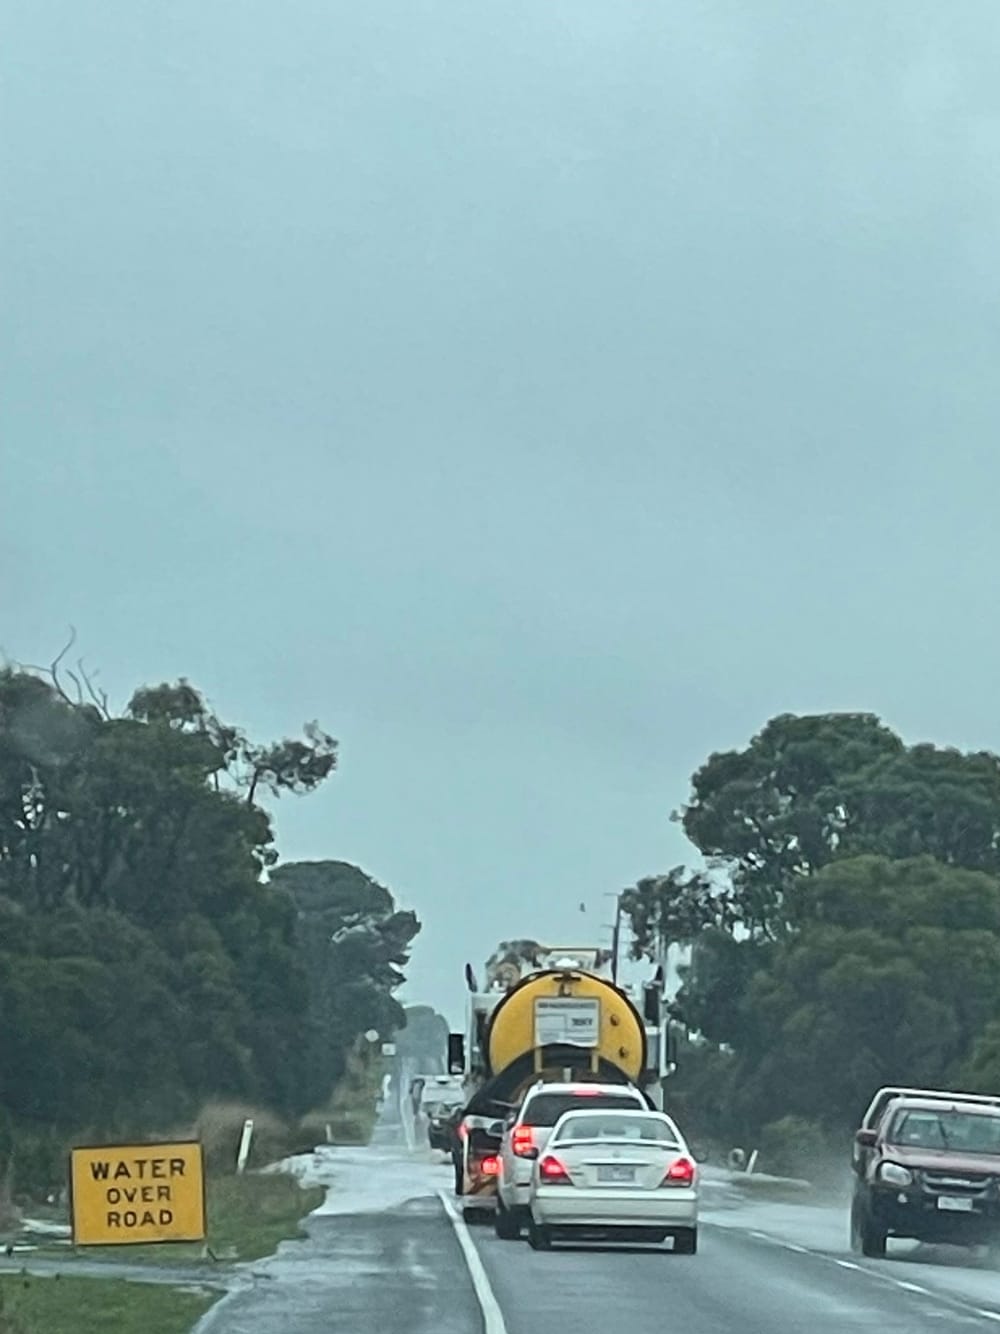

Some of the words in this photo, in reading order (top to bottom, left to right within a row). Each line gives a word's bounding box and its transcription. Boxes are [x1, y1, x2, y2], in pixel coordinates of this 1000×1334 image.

[90, 1158, 186, 1181] WATER
[106, 1185, 172, 1205] OVER
[107, 1209, 173, 1228] ROAD
